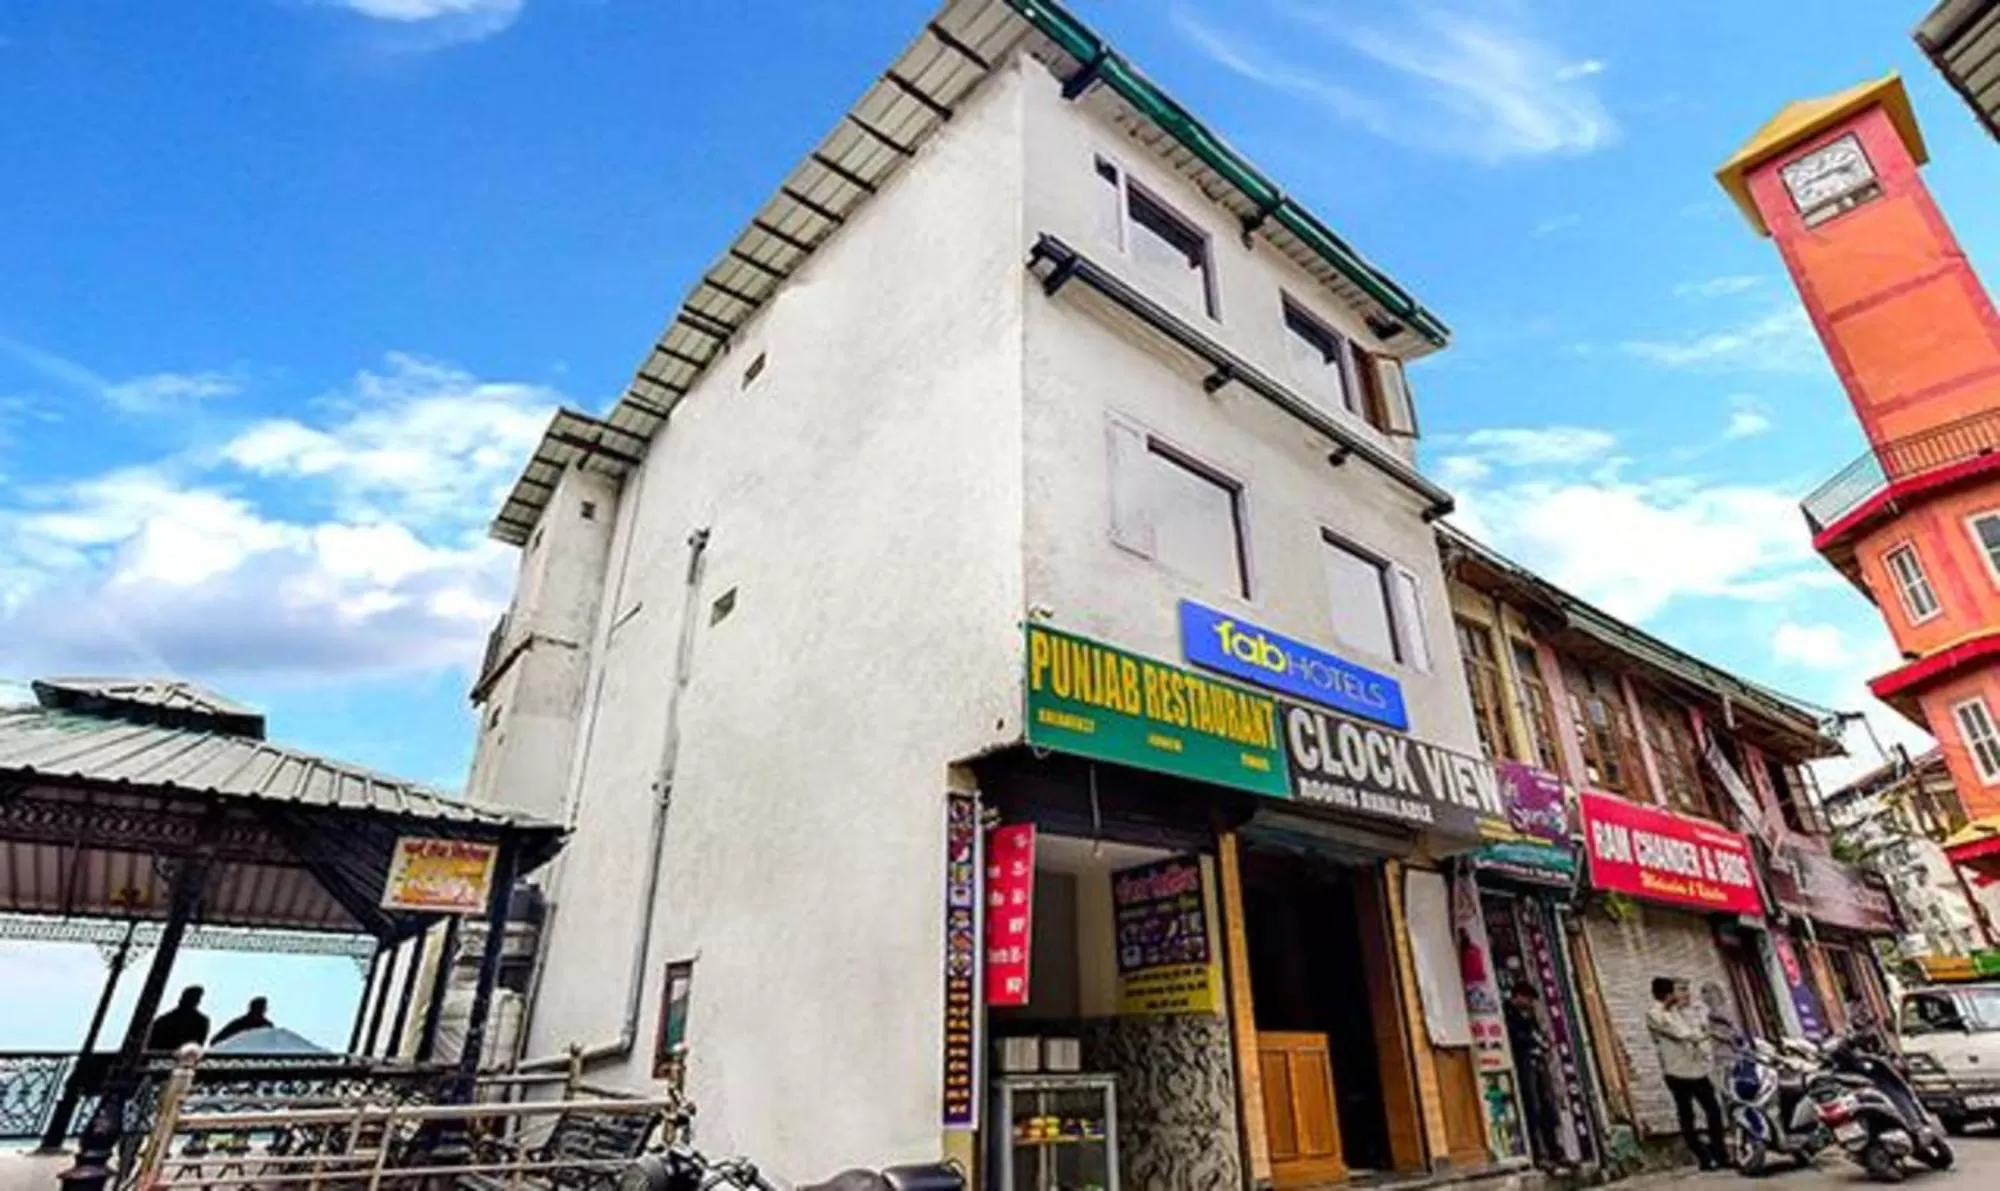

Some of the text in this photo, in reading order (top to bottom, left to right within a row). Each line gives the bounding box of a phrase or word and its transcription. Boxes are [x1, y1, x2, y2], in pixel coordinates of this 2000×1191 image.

[1031, 629, 1277, 750] PUNJAB RESTAURANT
[1288, 707, 1504, 816] CLOCK VIEW
